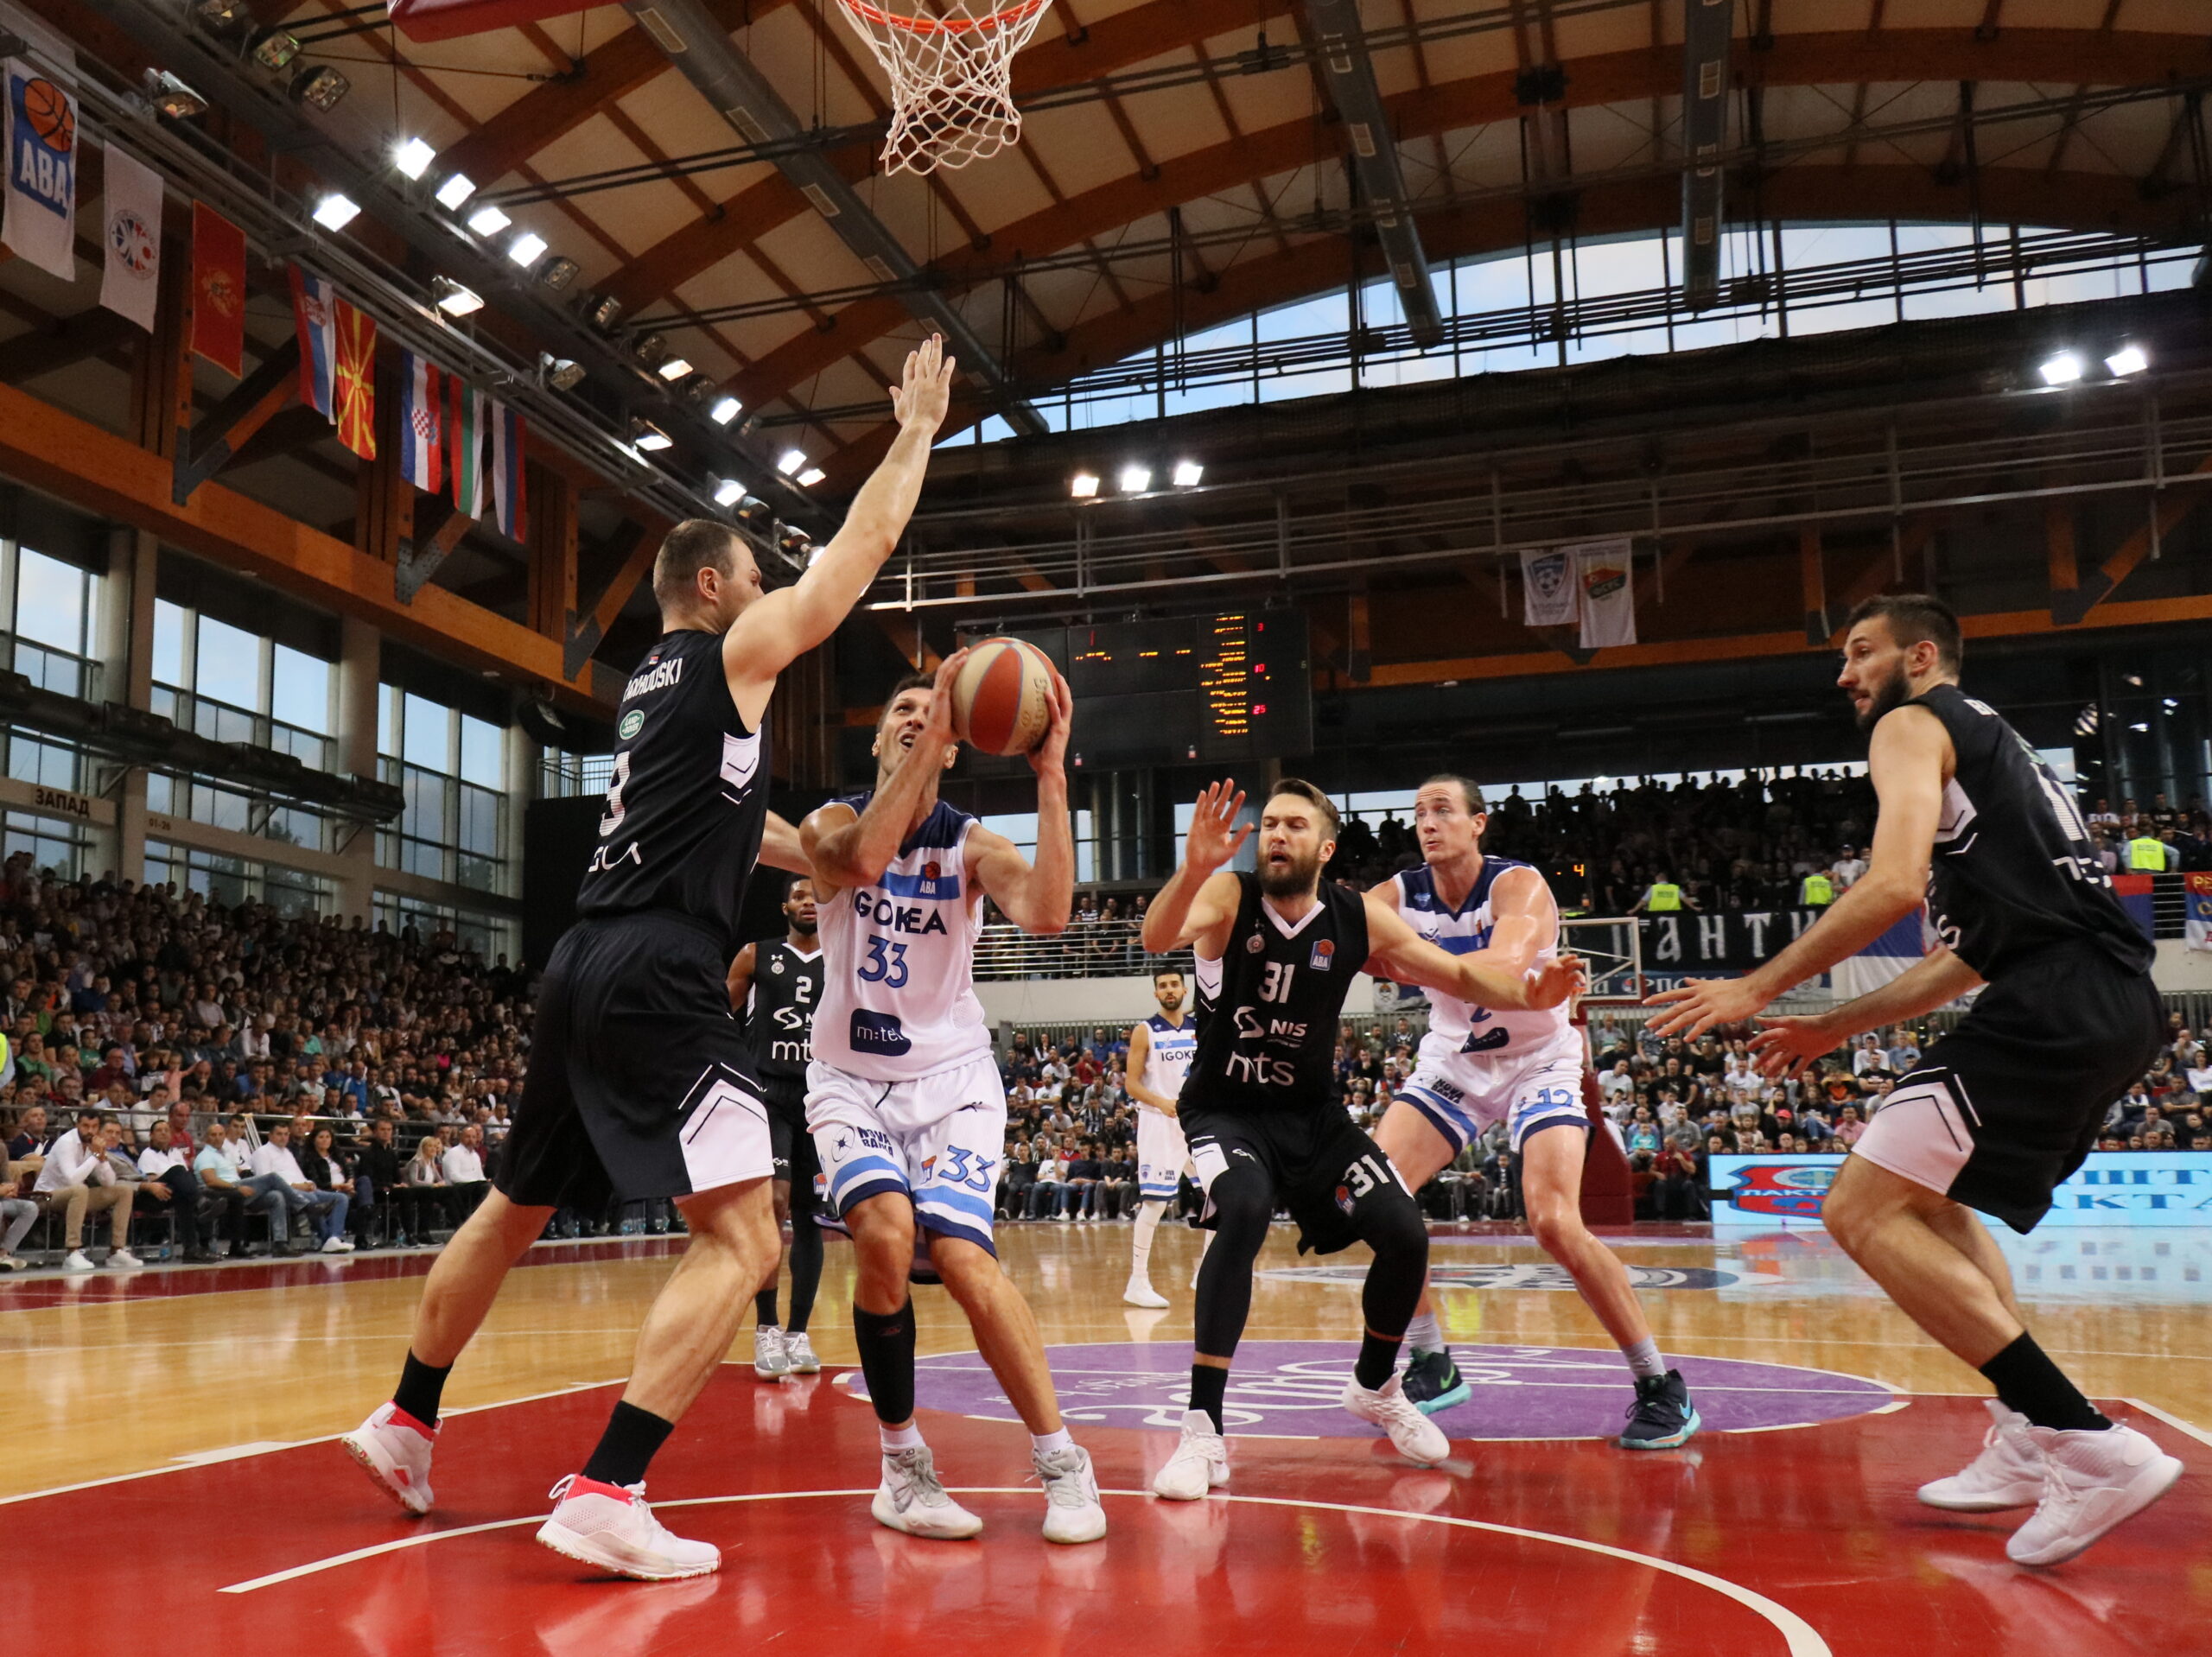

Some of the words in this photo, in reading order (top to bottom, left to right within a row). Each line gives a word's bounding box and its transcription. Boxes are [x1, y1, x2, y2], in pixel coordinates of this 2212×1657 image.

[20, 138, 68, 209] ABA
[35, 788, 90, 818] ЗАПАД
[919, 880, 936, 894] ABA
[849, 887, 947, 935] GOKEA
[856, 934, 908, 988] 33
[1312, 955, 1329, 968] ABA
[795, 975, 812, 1004] 2
[1257, 960, 1296, 1004] 31
[856, 1025, 905, 1042] m:tel
[1269, 1019, 1308, 1037] NIS
[771, 1038, 814, 1063] mt
[939, 1145, 996, 1193] 33
[1342, 1154, 1391, 1198] 31
